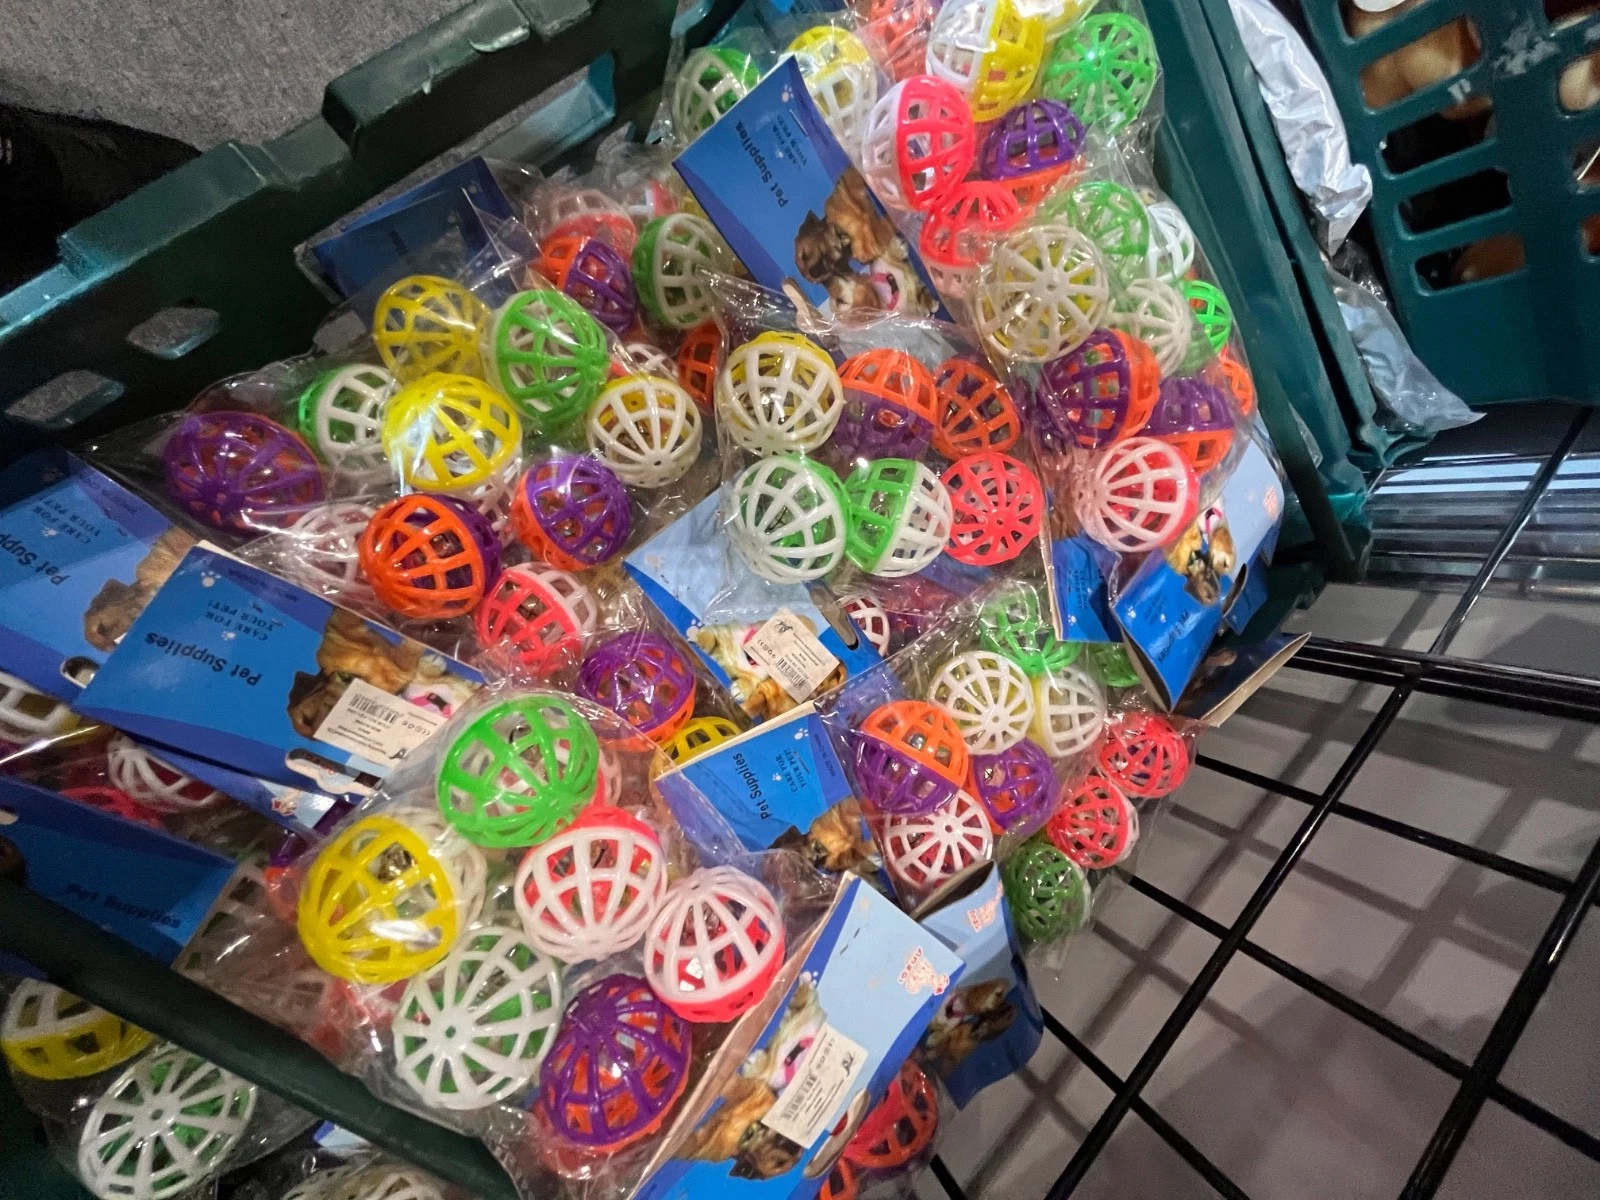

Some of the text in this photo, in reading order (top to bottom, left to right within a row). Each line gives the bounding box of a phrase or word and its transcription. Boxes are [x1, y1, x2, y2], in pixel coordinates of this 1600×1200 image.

[735, 121, 789, 208] Pet Supplies
[34, 561, 71, 586] Pet
[204, 610, 232, 627] FOR
[144, 632, 263, 687] Pet Supplies
[733, 752, 773, 821] Pet Supplies
